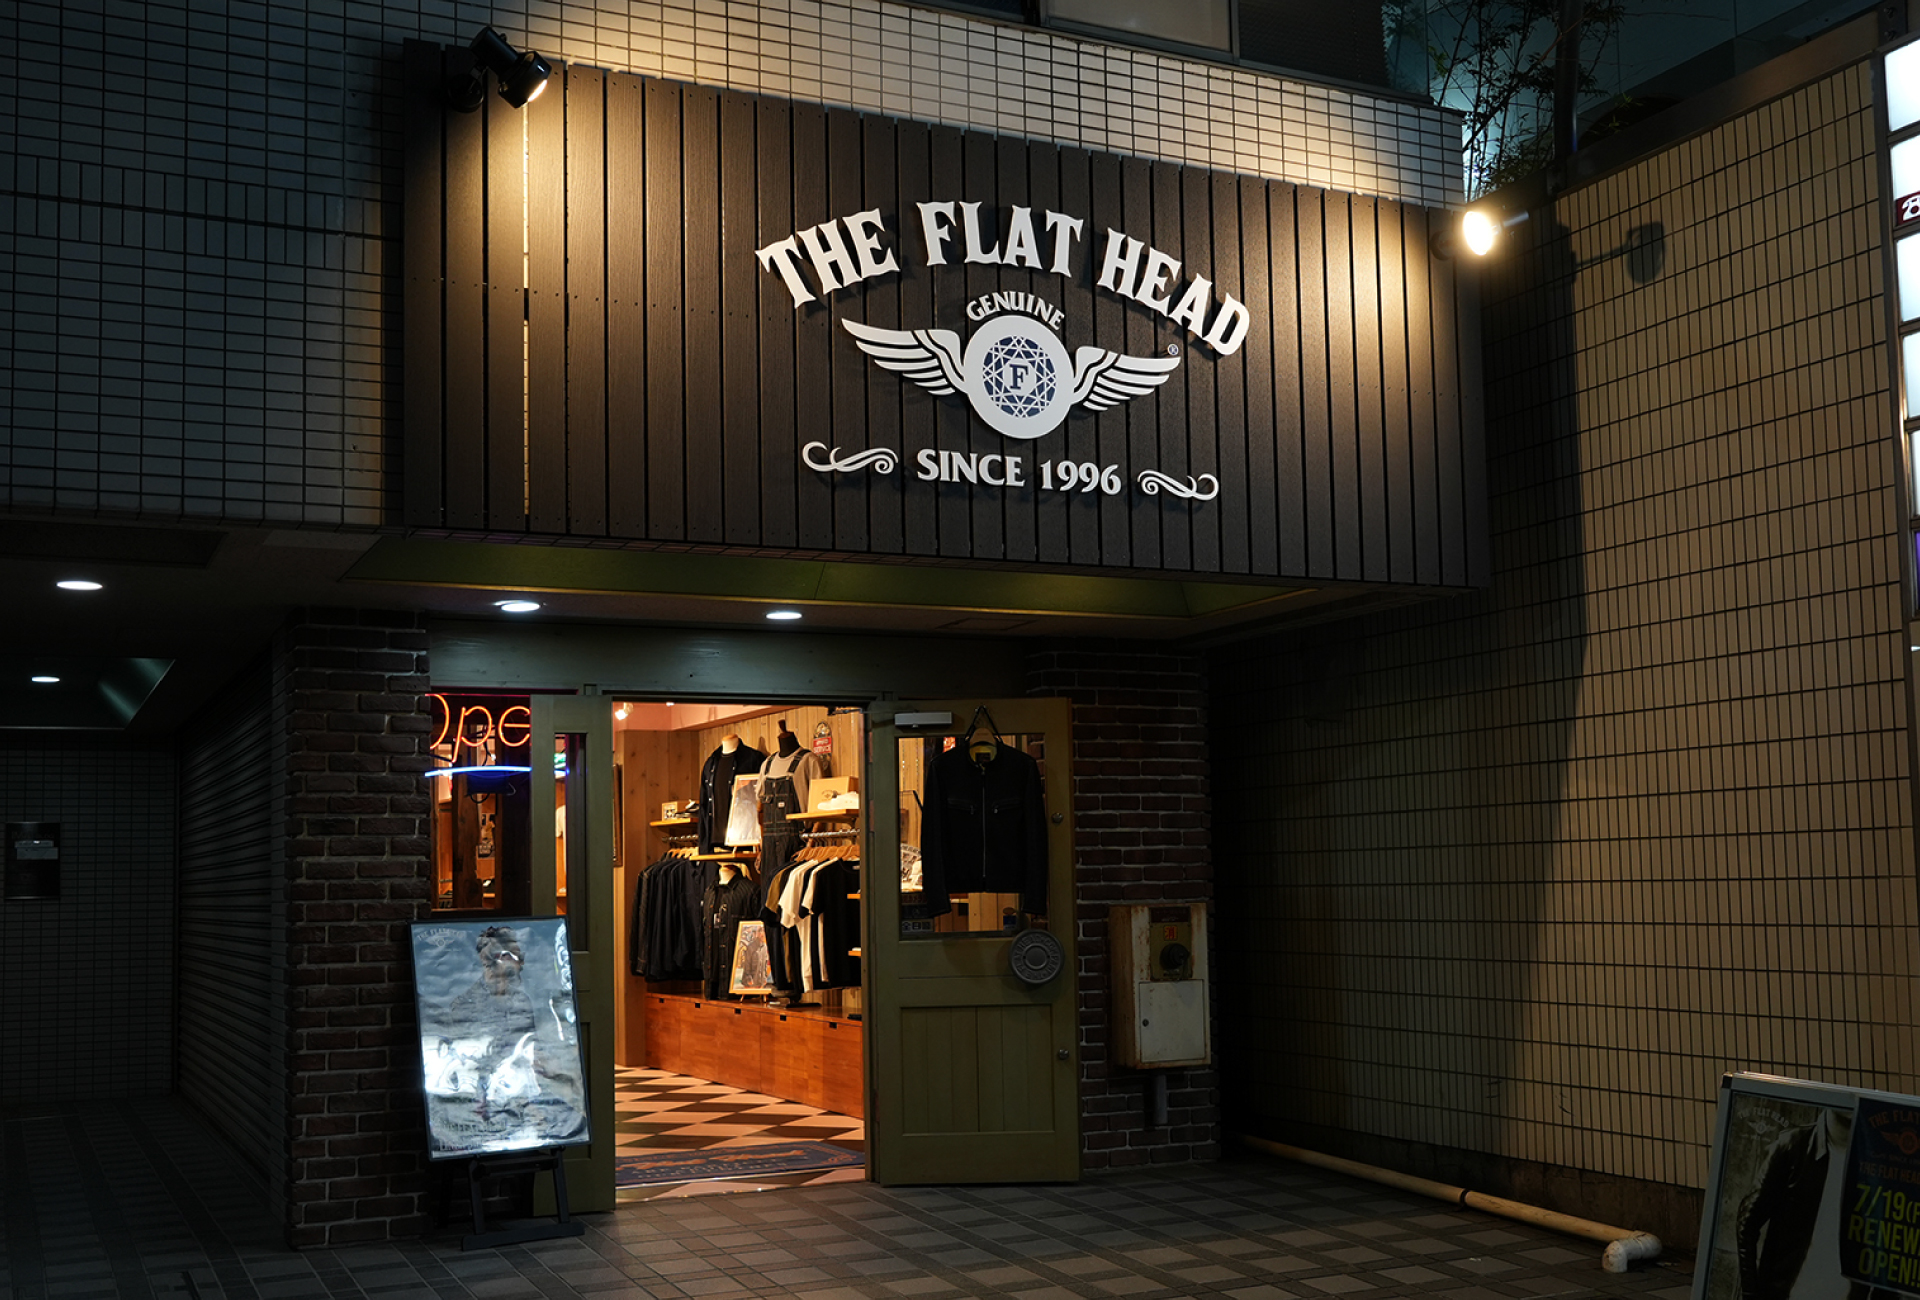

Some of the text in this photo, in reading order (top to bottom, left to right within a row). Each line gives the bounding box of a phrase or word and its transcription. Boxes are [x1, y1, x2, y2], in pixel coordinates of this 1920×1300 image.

[754, 201, 1250, 356] THE FLAT HEAD
[966, 291, 1065, 330] GENUINE
[1008, 363, 1029, 390] F
[916, 448, 1122, 496] SINCE 1996
[1868, 1111, 1889, 1128] THE
[1859, 1162, 1876, 1176] THE
[1878, 1164, 1899, 1179] FLAT
[1847, 1212, 1920, 1256] RENEW
